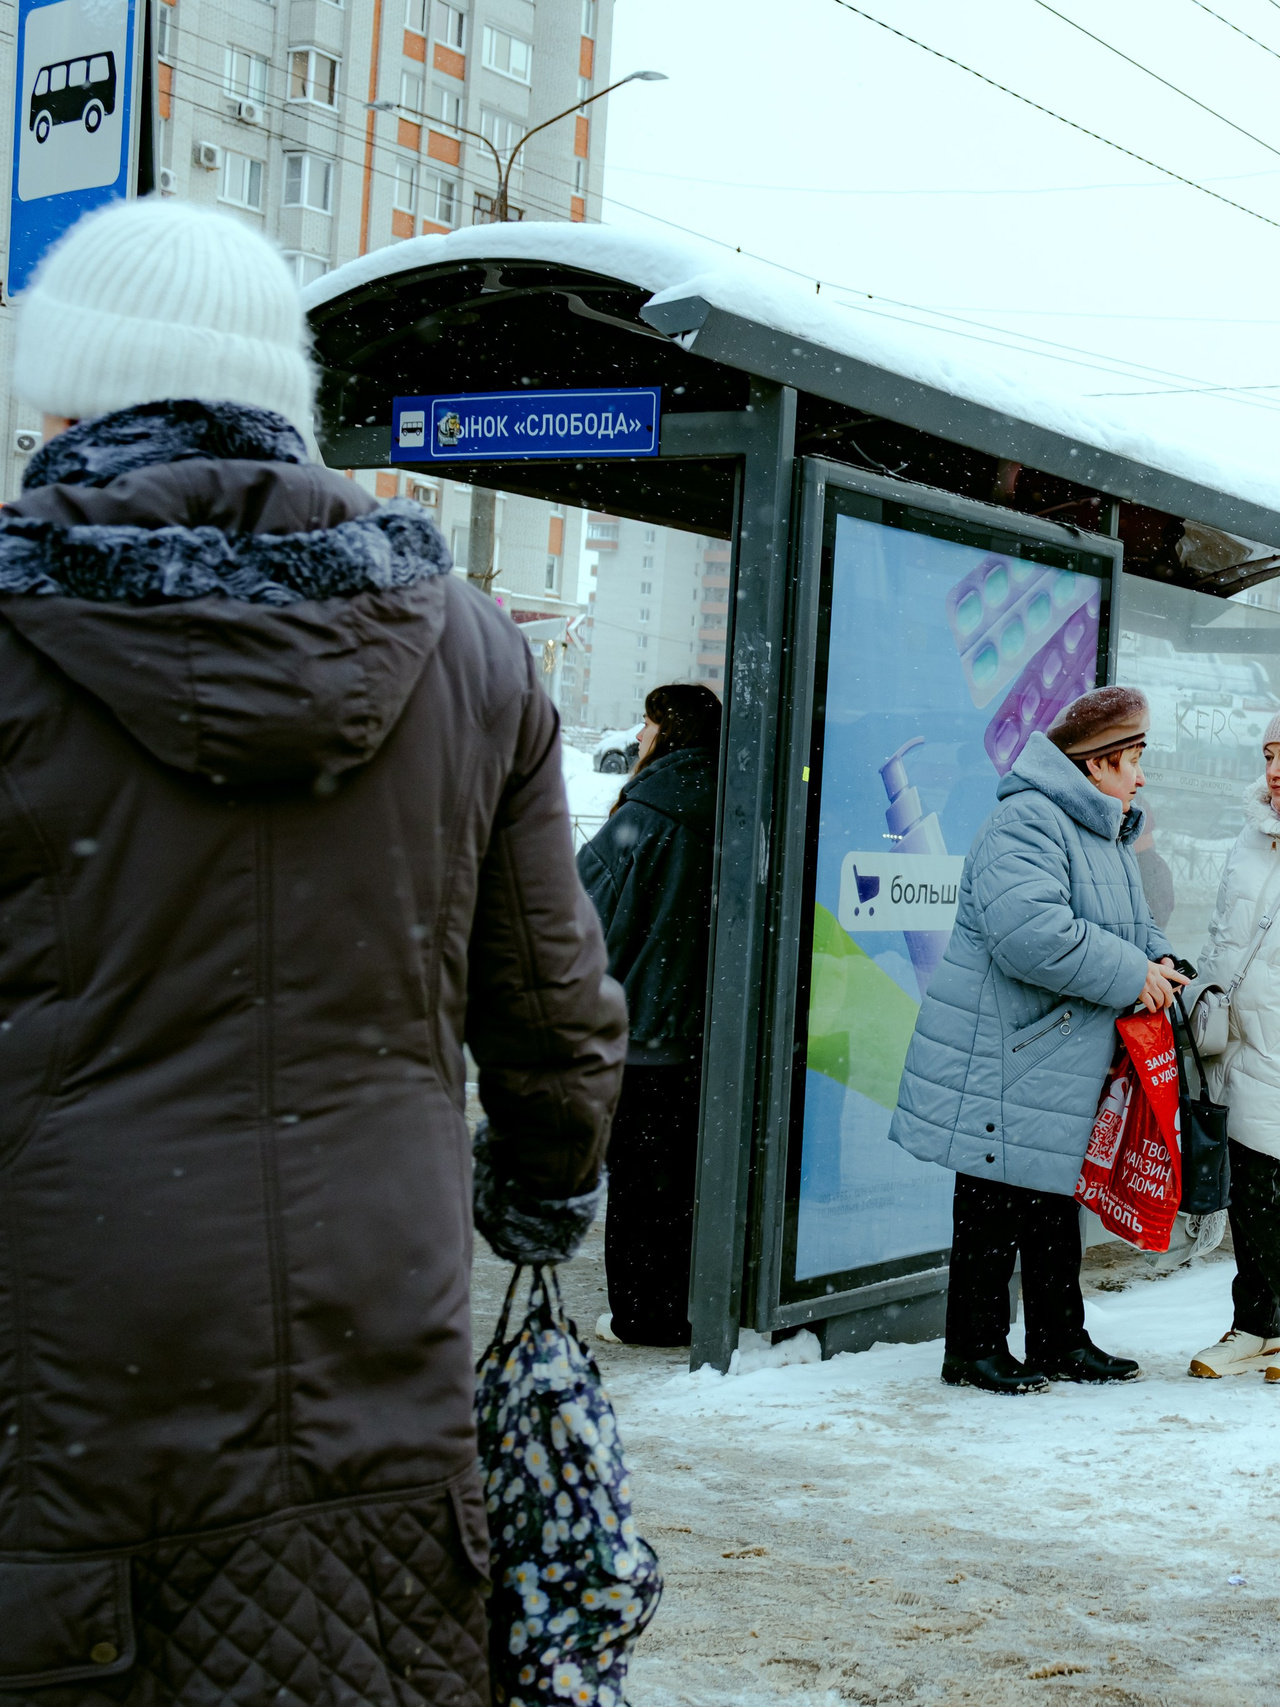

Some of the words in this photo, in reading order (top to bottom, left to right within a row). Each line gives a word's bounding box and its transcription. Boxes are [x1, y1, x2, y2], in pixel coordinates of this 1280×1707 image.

[454, 415, 508, 439] ЫНОК
[514, 412, 641, 440] «СЛОБОДА»
[891, 875, 957, 905] больш
[1151, 1075, 1159, 1087] В
[1158, 1064, 1178, 1083] УДО
[1121, 1165, 1129, 1180] У
[1127, 1172, 1164, 1200] ДОМА
